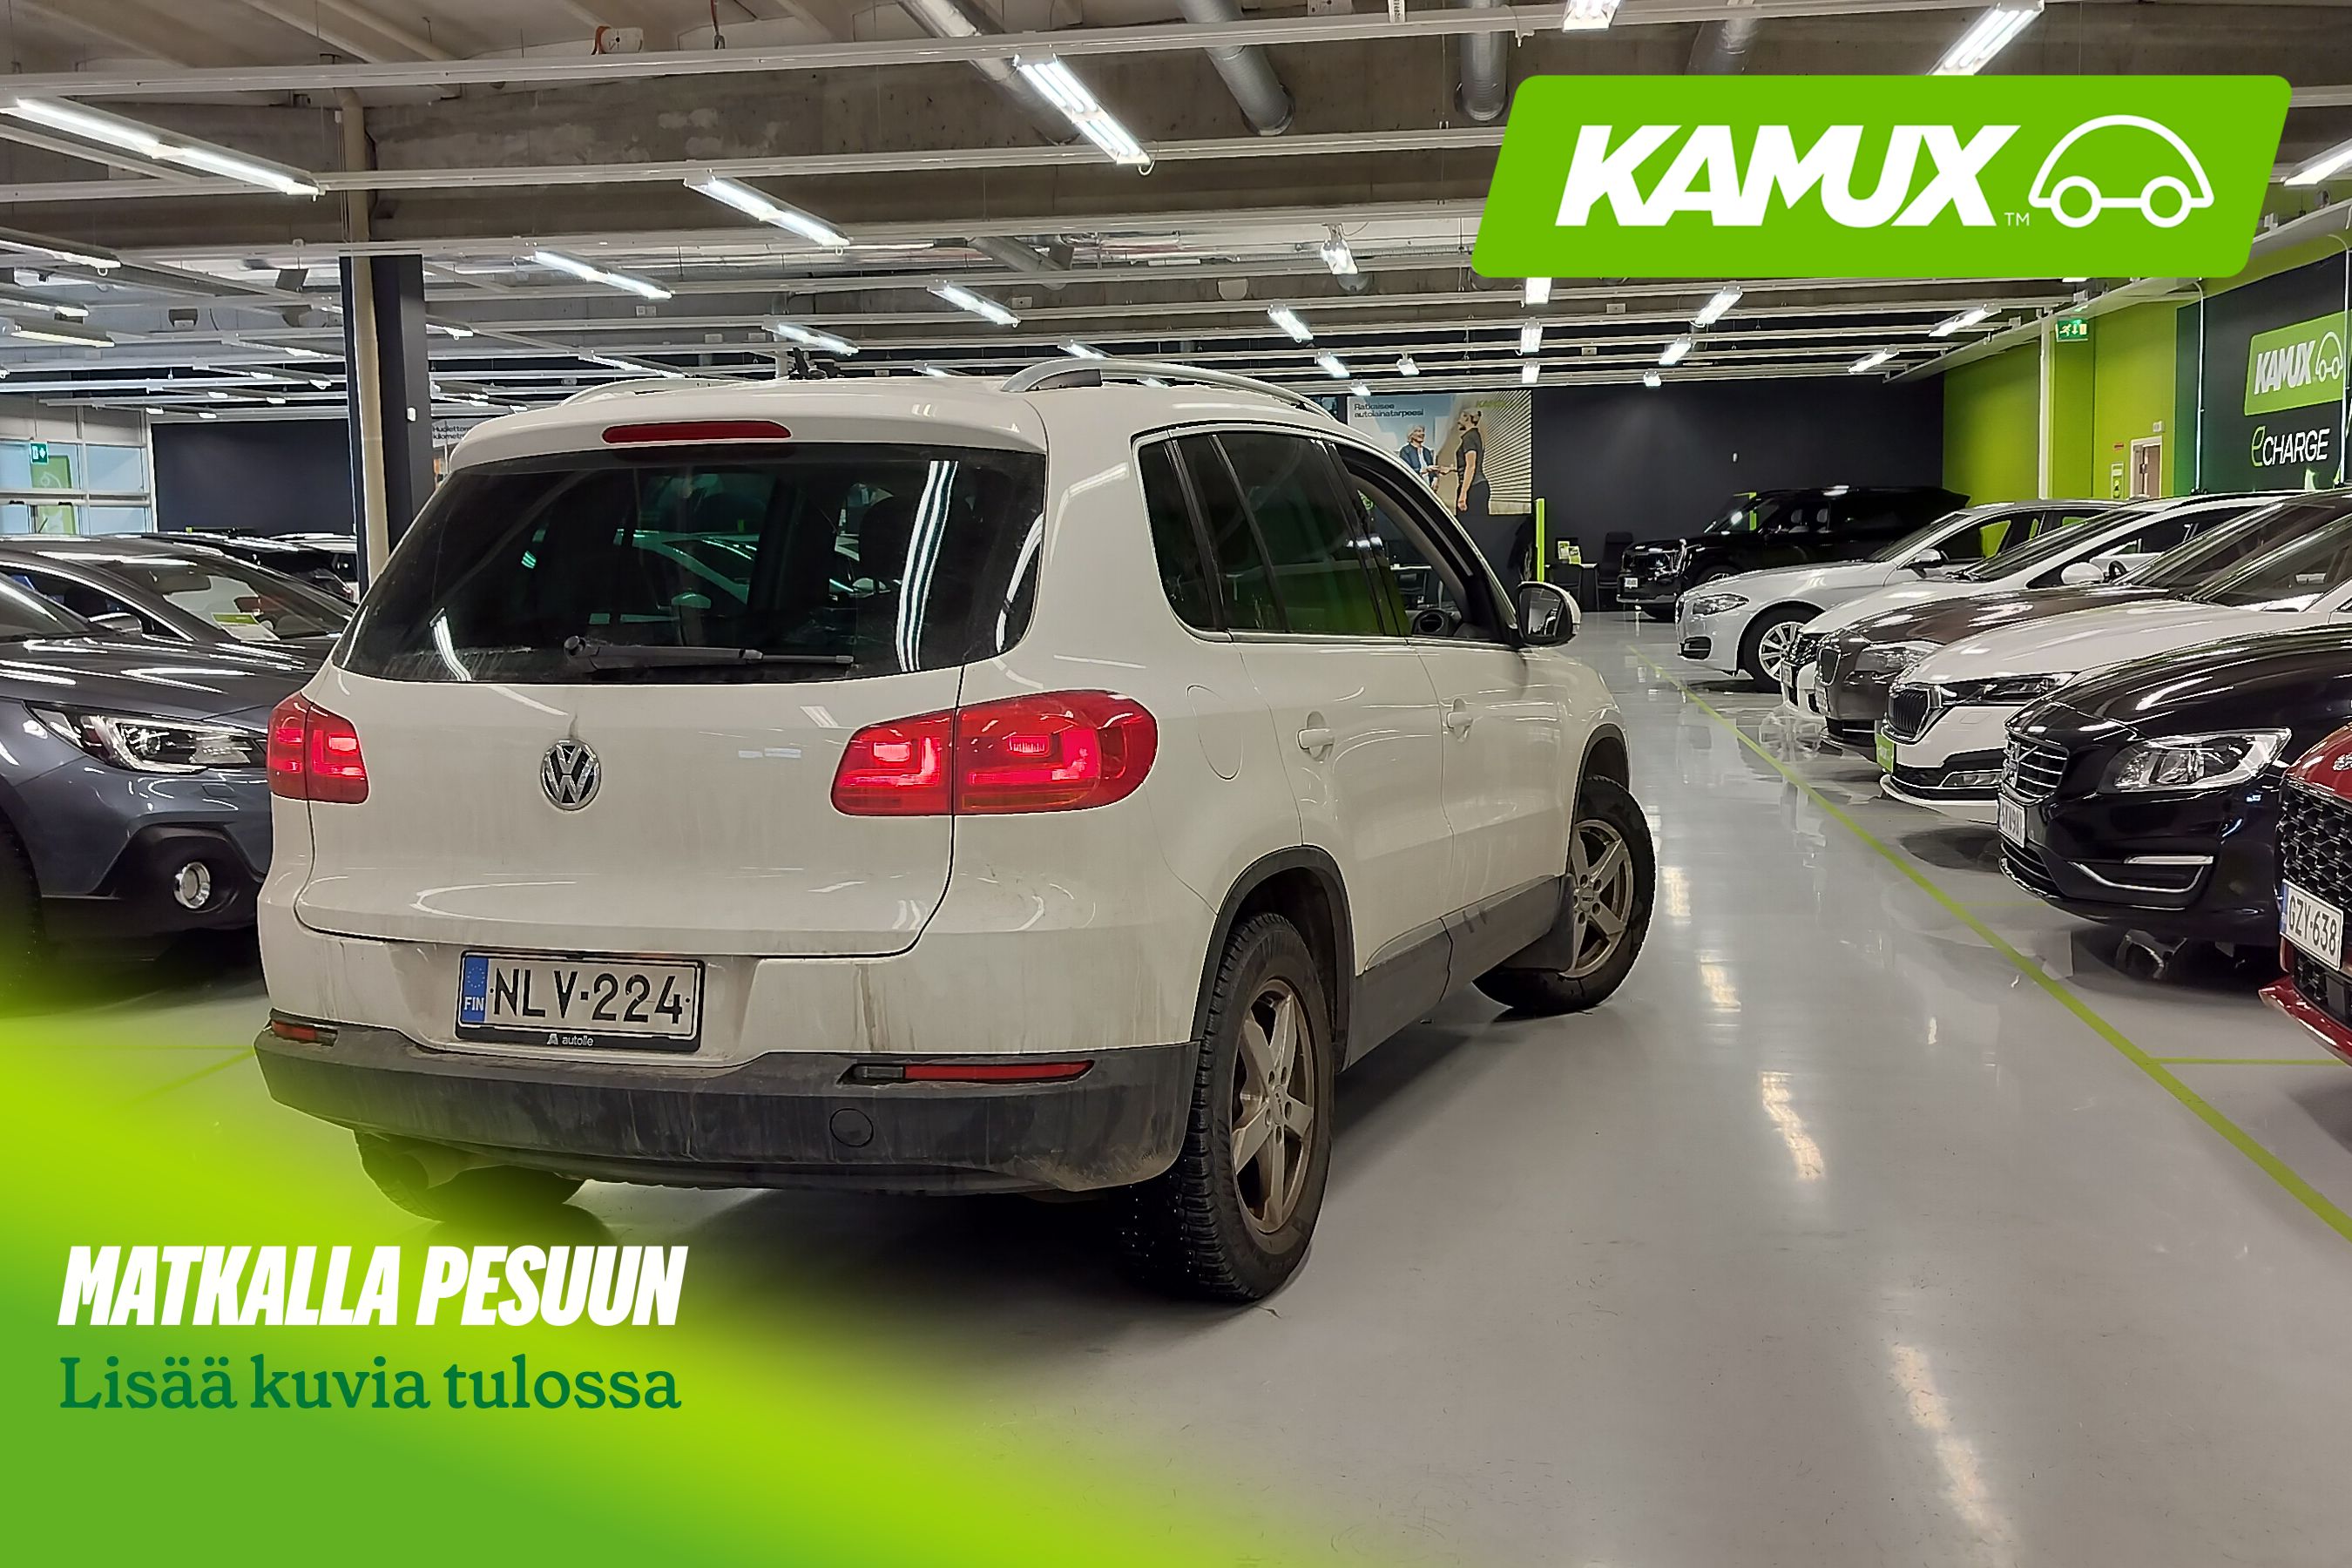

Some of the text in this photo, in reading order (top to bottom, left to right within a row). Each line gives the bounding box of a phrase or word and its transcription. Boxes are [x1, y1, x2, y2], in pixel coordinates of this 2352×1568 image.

[2254, 340, 2316, 395] KAMUX
[2288, 895, 2337, 956] GZY-638
[463, 967, 683, 1024] FIN NLV-224
